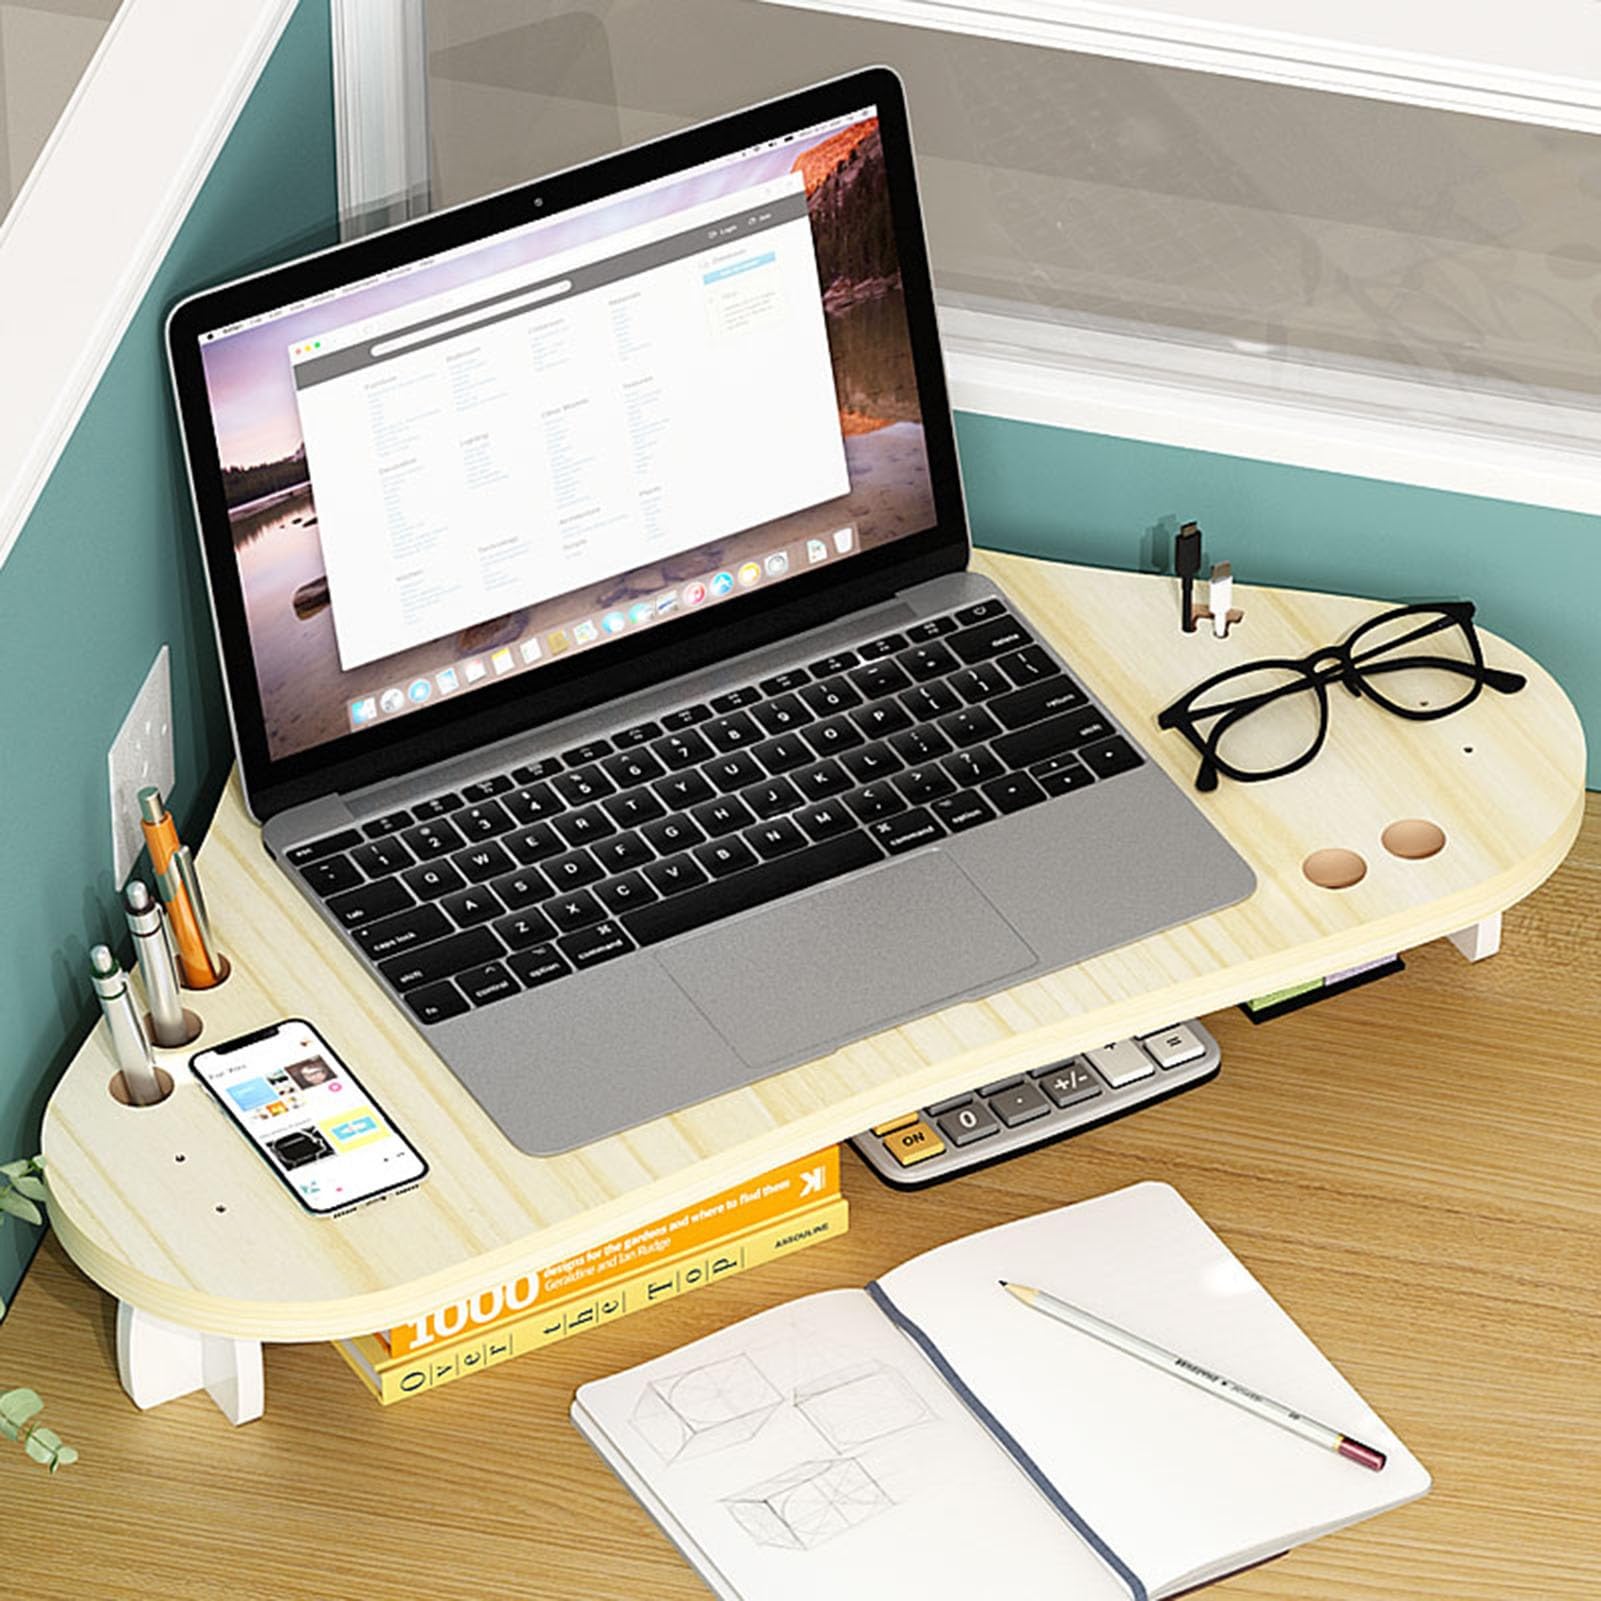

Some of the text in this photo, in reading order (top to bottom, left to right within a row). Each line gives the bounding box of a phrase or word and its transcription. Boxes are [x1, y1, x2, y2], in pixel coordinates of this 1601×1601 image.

[1053, 1071, 1089, 1090] +/-
[959, 1110, 978, 1129] 0
[901, 1130, 926, 1147] ON
[586, 1249, 603, 1263] for
[603, 1242, 623, 1256] the
[623, 1225, 668, 1251] gardens
[668, 1215, 689, 1232] and
[690, 1203, 724, 1224] where
[725, 1199, 738, 1210] to
[738, 1188, 761, 1206] find
[762, 1179, 792, 1197] them
[774, 1222, 830, 1249] ASSOULINE
[544, 1267, 596, 1292] Geraldine
[597, 1256, 618, 1273] and
[637, 1237, 672, 1257] Rudge
[408, 1271, 541, 1350] 1000
